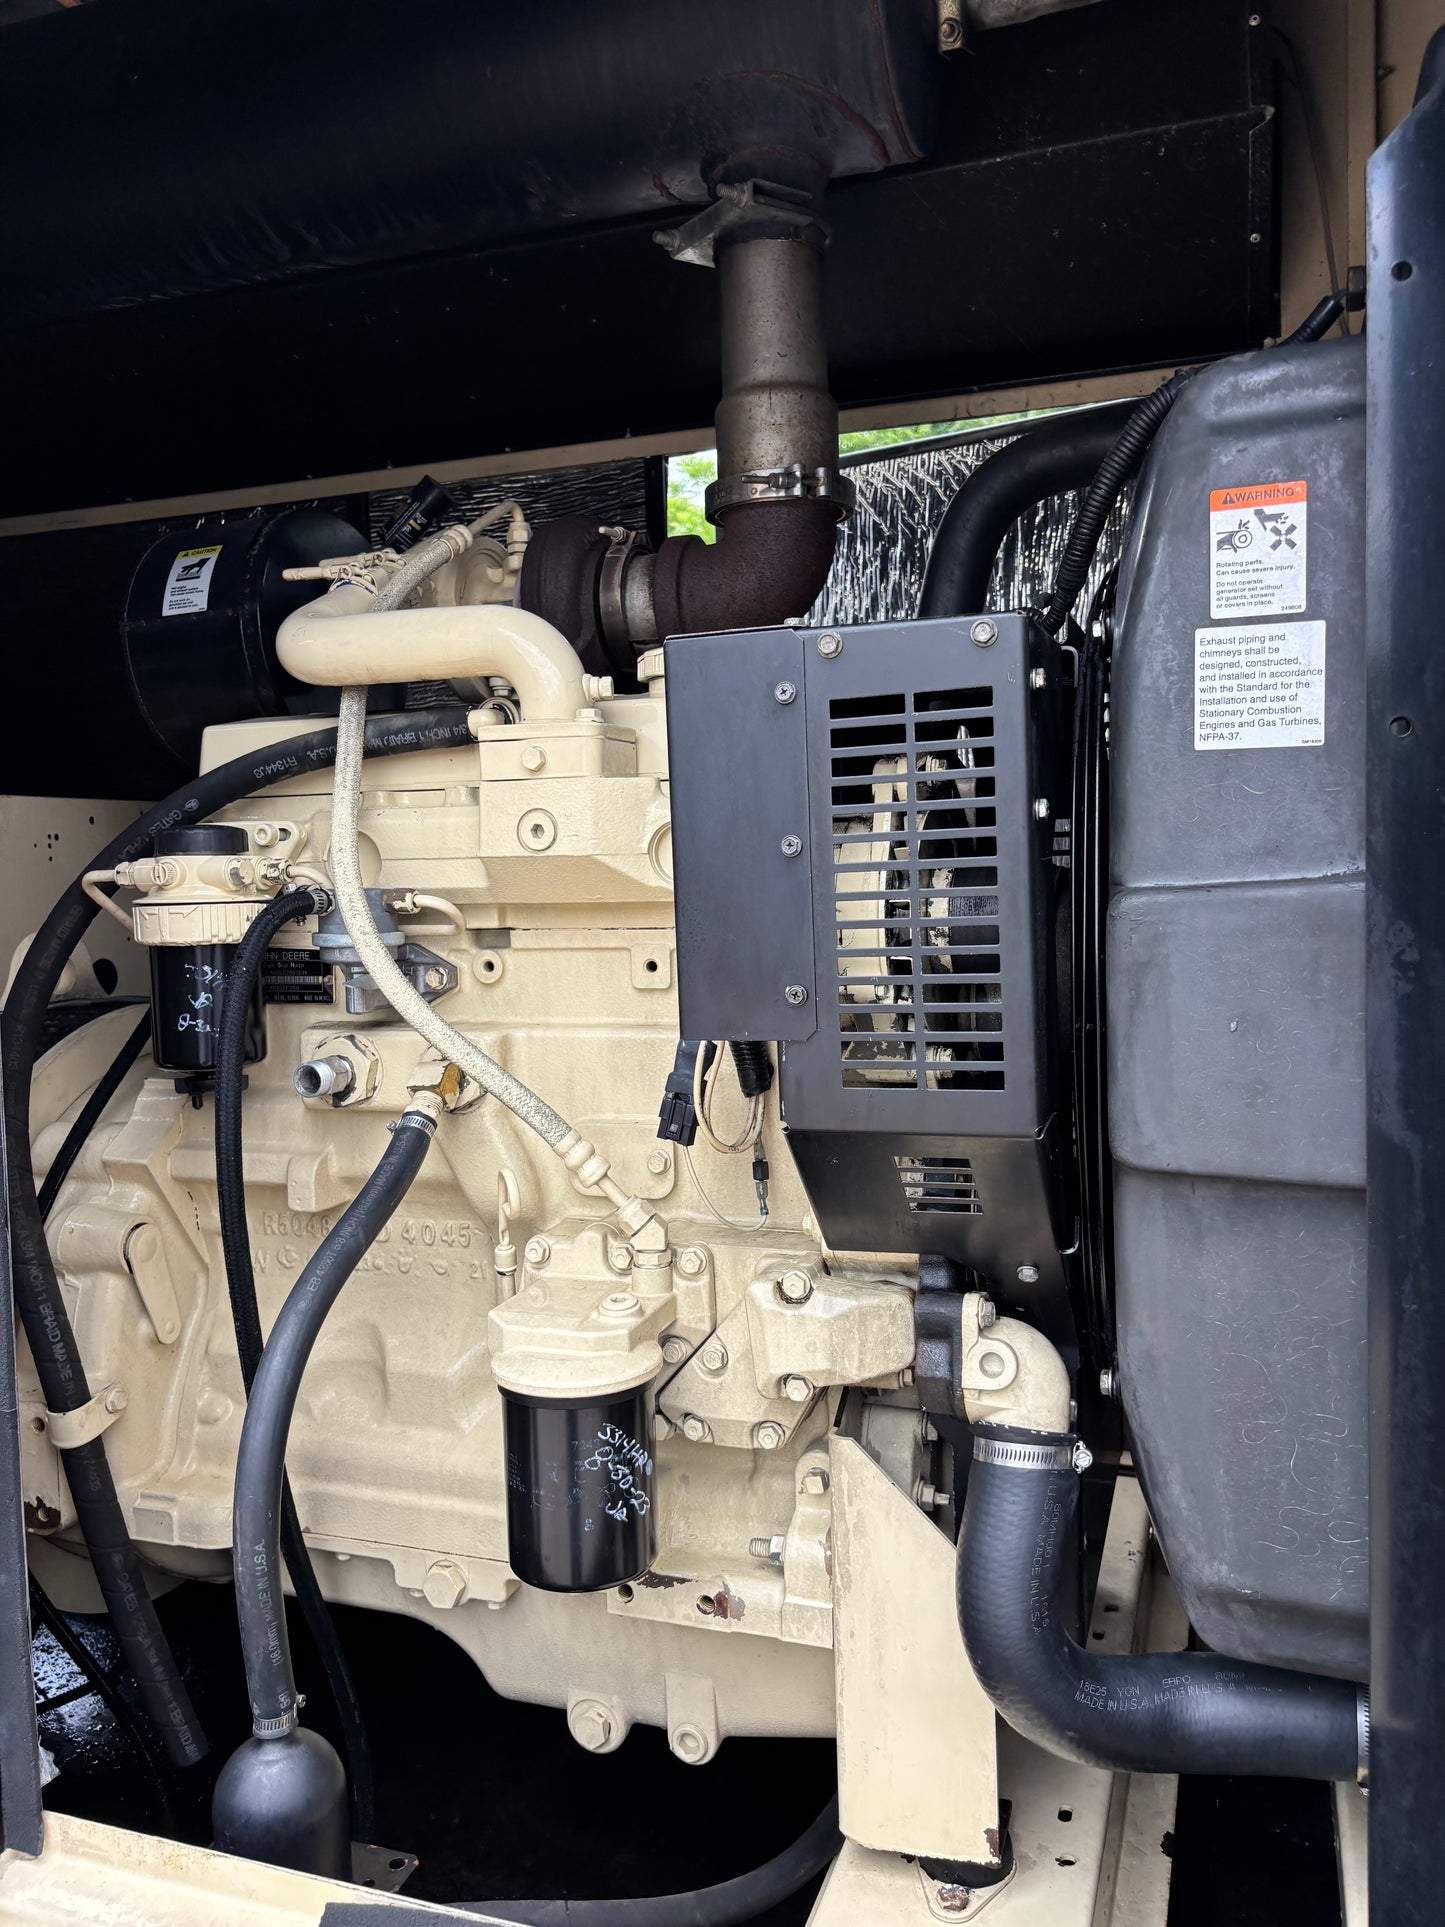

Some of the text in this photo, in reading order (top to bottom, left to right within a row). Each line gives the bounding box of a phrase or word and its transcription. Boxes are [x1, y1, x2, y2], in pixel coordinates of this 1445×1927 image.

[1234, 487, 1294, 500] WARNING
[1216, 560, 1243, 568] Rotating
[1238, 578, 1262, 586] operate
[1216, 587, 1246, 595] generator
[1224, 594, 1248, 602] guards,
[1254, 599, 1273, 607] place.
[1199, 632, 1285, 646] Exhaust piping and
[1199, 645, 1279, 658] chimneys shall be
[1199, 656, 1301, 670] designed, constructed,
[1199, 667, 1322, 682] and installed in accordance
[1199, 685, 1216, 693] with
[1236, 682, 1277, 692] Standard
[1280, 681, 1293, 689] for
[1199, 692, 1297, 705] Installation and use of
[1199, 705, 1301, 718] Stationary Combustion
[1199, 717, 1321, 731] Engines and Gas Turbines,
[1199, 732, 1242, 741] NFPA-37.
[282, 951, 310, 959] DEERE
[340, 1216, 358, 1239] INCH
[374, 1164, 394, 1190] MADE
[389, 1152, 400, 1164] IN
[401, 1219, 472, 1247] 4045
[254, 1538, 268, 1572] U.S.A.
[257, 1576, 270, 1591] IN
[1030, 1579, 1040, 1594] IN
[1079, 1679, 1108, 1697] 18E25
[1116, 1685, 1140, 1697] YGN
[1074, 1691, 1105, 1711] MADE
[1107, 1700, 1117, 1711] IN
[1154, 1687, 1185, 1705] MADE
[1186, 1685, 1200, 1698] IN
